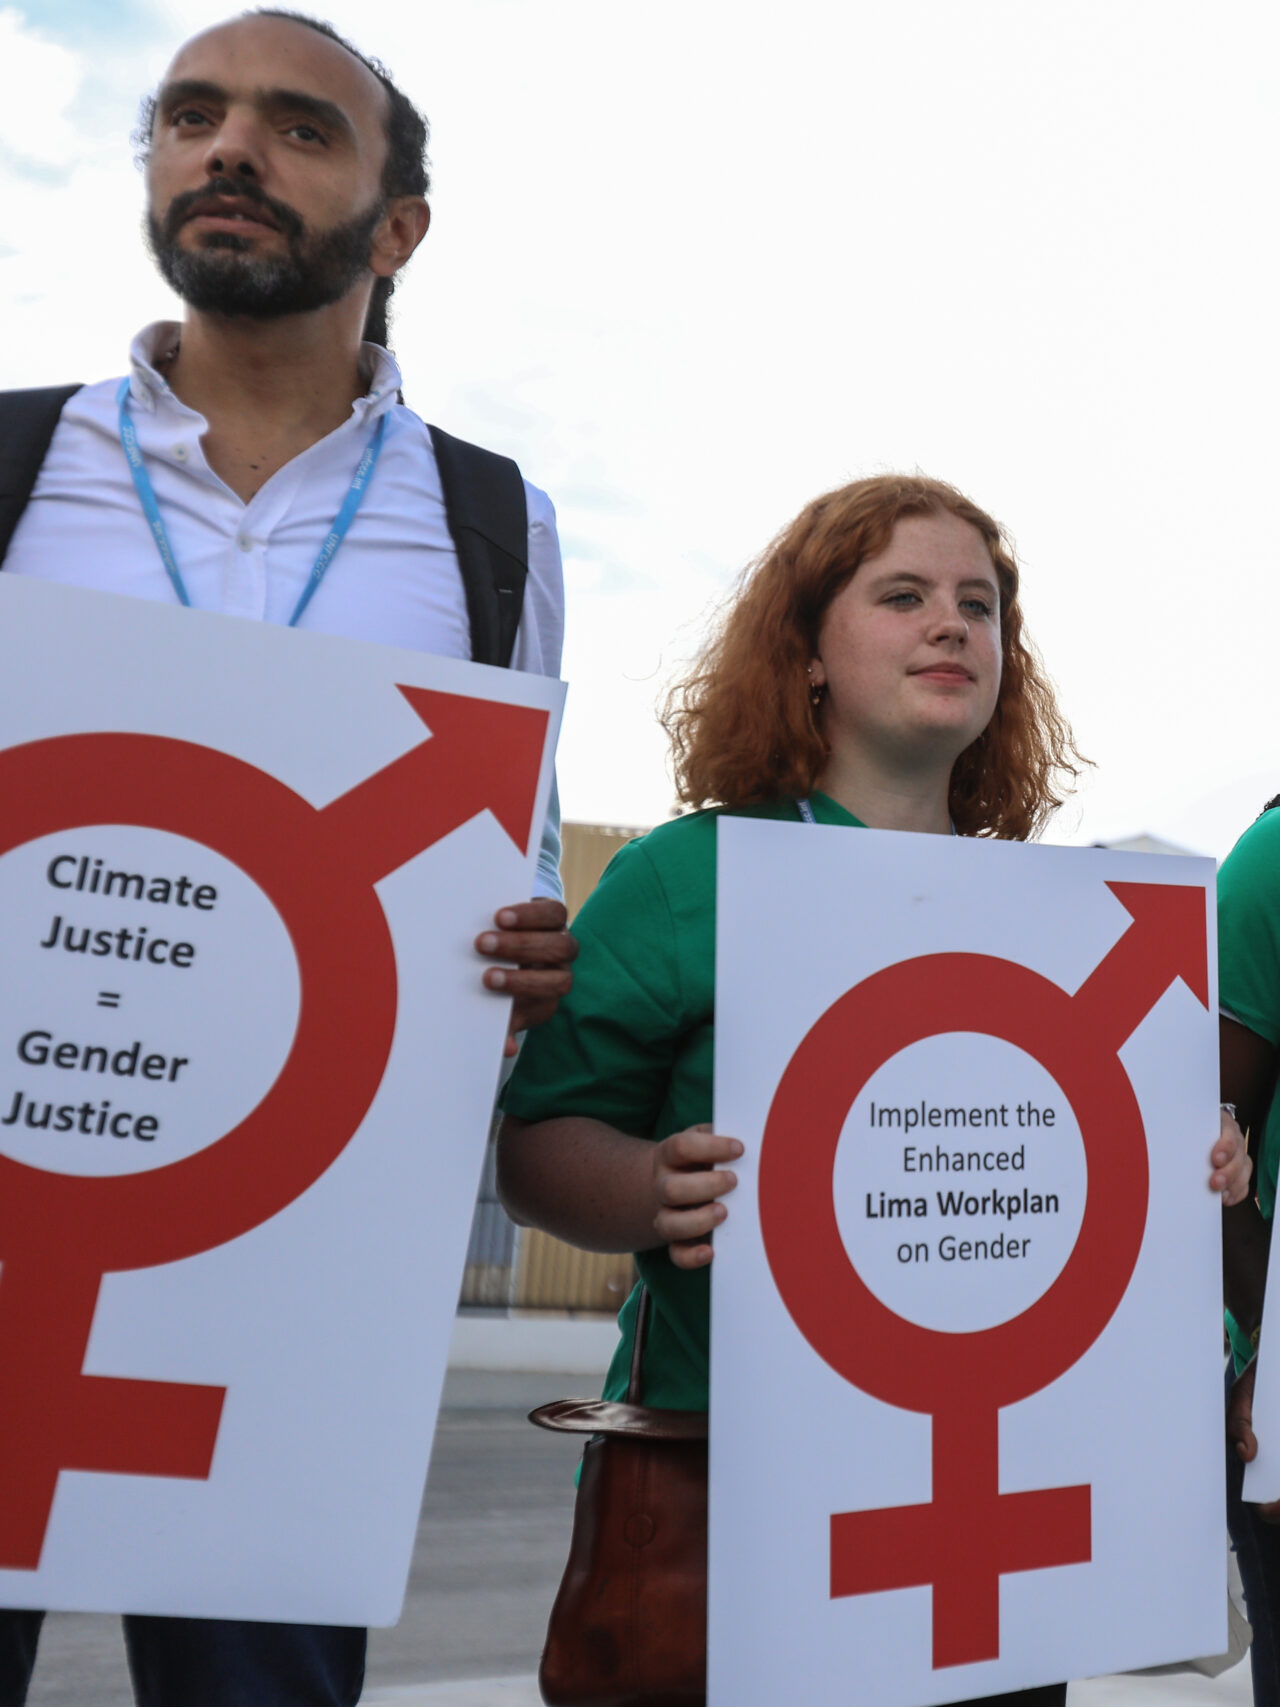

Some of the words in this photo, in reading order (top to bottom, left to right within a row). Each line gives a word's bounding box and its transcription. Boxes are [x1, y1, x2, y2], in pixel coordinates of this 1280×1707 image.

[46, 854, 219, 911] Climate
[40, 915, 196, 969] Justice
[17, 1030, 189, 1084] Gender
[0, 1090, 160, 1143] Justice
[870, 1100, 1009, 1135] Implement
[1015, 1100, 1056, 1128] the
[903, 1143, 1025, 1173] Enhanced
[865, 1191, 928, 1220] Lima
[935, 1187, 1060, 1222] Workplan
[896, 1242, 929, 1264] on
[937, 1232, 1032, 1262] Gender
